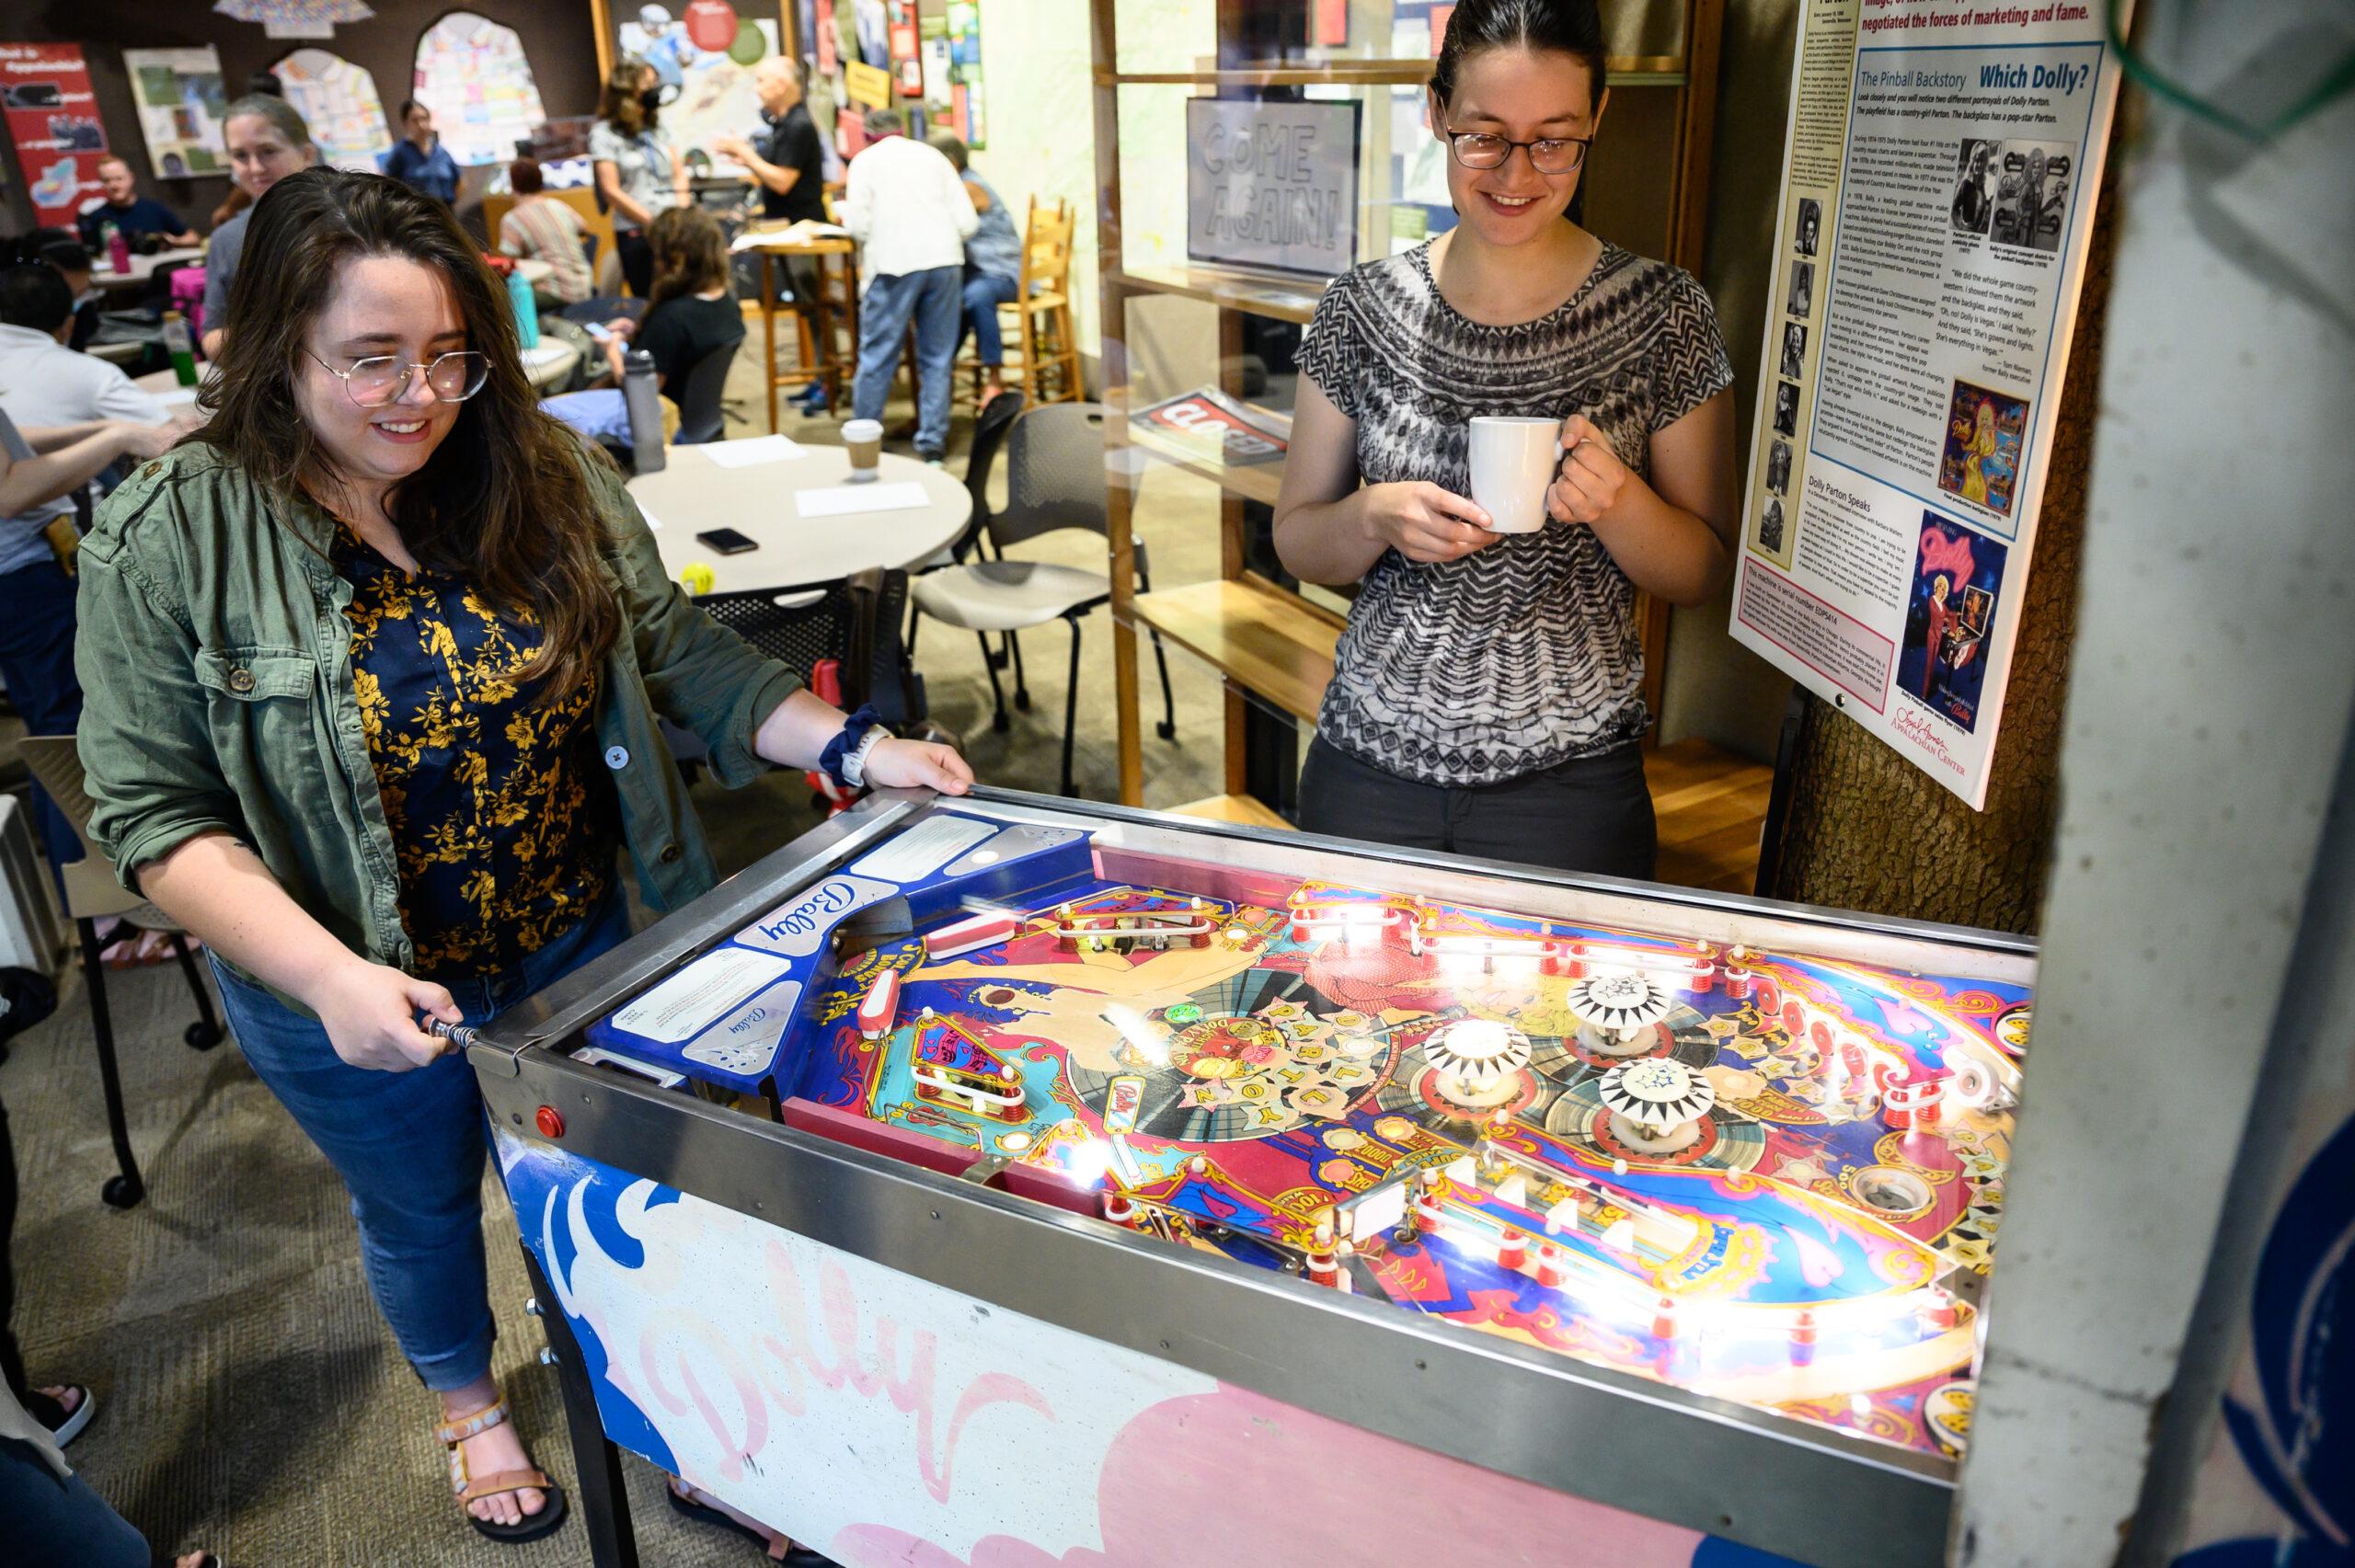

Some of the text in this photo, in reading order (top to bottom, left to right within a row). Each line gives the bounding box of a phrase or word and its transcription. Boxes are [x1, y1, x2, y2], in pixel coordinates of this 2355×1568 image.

[1862, 13, 1910, 34] negotiated
[1912, 12, 1928, 28] the
[1928, 10, 1959, 27] forces
[1961, 9, 1974, 25] of
[1974, 7, 2029, 29] marketing
[2031, 6, 2055, 22] and
[2055, 4, 2088, 21] fame.
[1861, 63, 2089, 96] The Pinball Backstory Which Dolly?
[1856, 105, 1865, 114] The
[1865, 106, 1888, 117] playfield
[1888, 107, 1897, 116] has
[1901, 107, 1931, 119] country-girl
[1932, 109, 1950, 118] Parton.
[1952, 109, 1962, 119] The
[1962, 109, 1991, 121] backglass
[1991, 111, 2002, 120] has
[2007, 112, 2034, 123] pop-star
[2035, 113, 2057, 122] Parton.
[1858, 92, 2050, 108] Look closely and you will notice two different portrayals of Dolly Parton.
[1204, 122, 1316, 183] COME
[1205, 186, 1339, 250] AGAIN!
[1160, 403, 1279, 454] CLOSED
[1809, 475, 1871, 512] Dolly Parton Speaks
[758, 882, 856, 941] Bally
[728, 1007, 766, 1035] Bally
[641, 1239, 1055, 1504] Dolly
